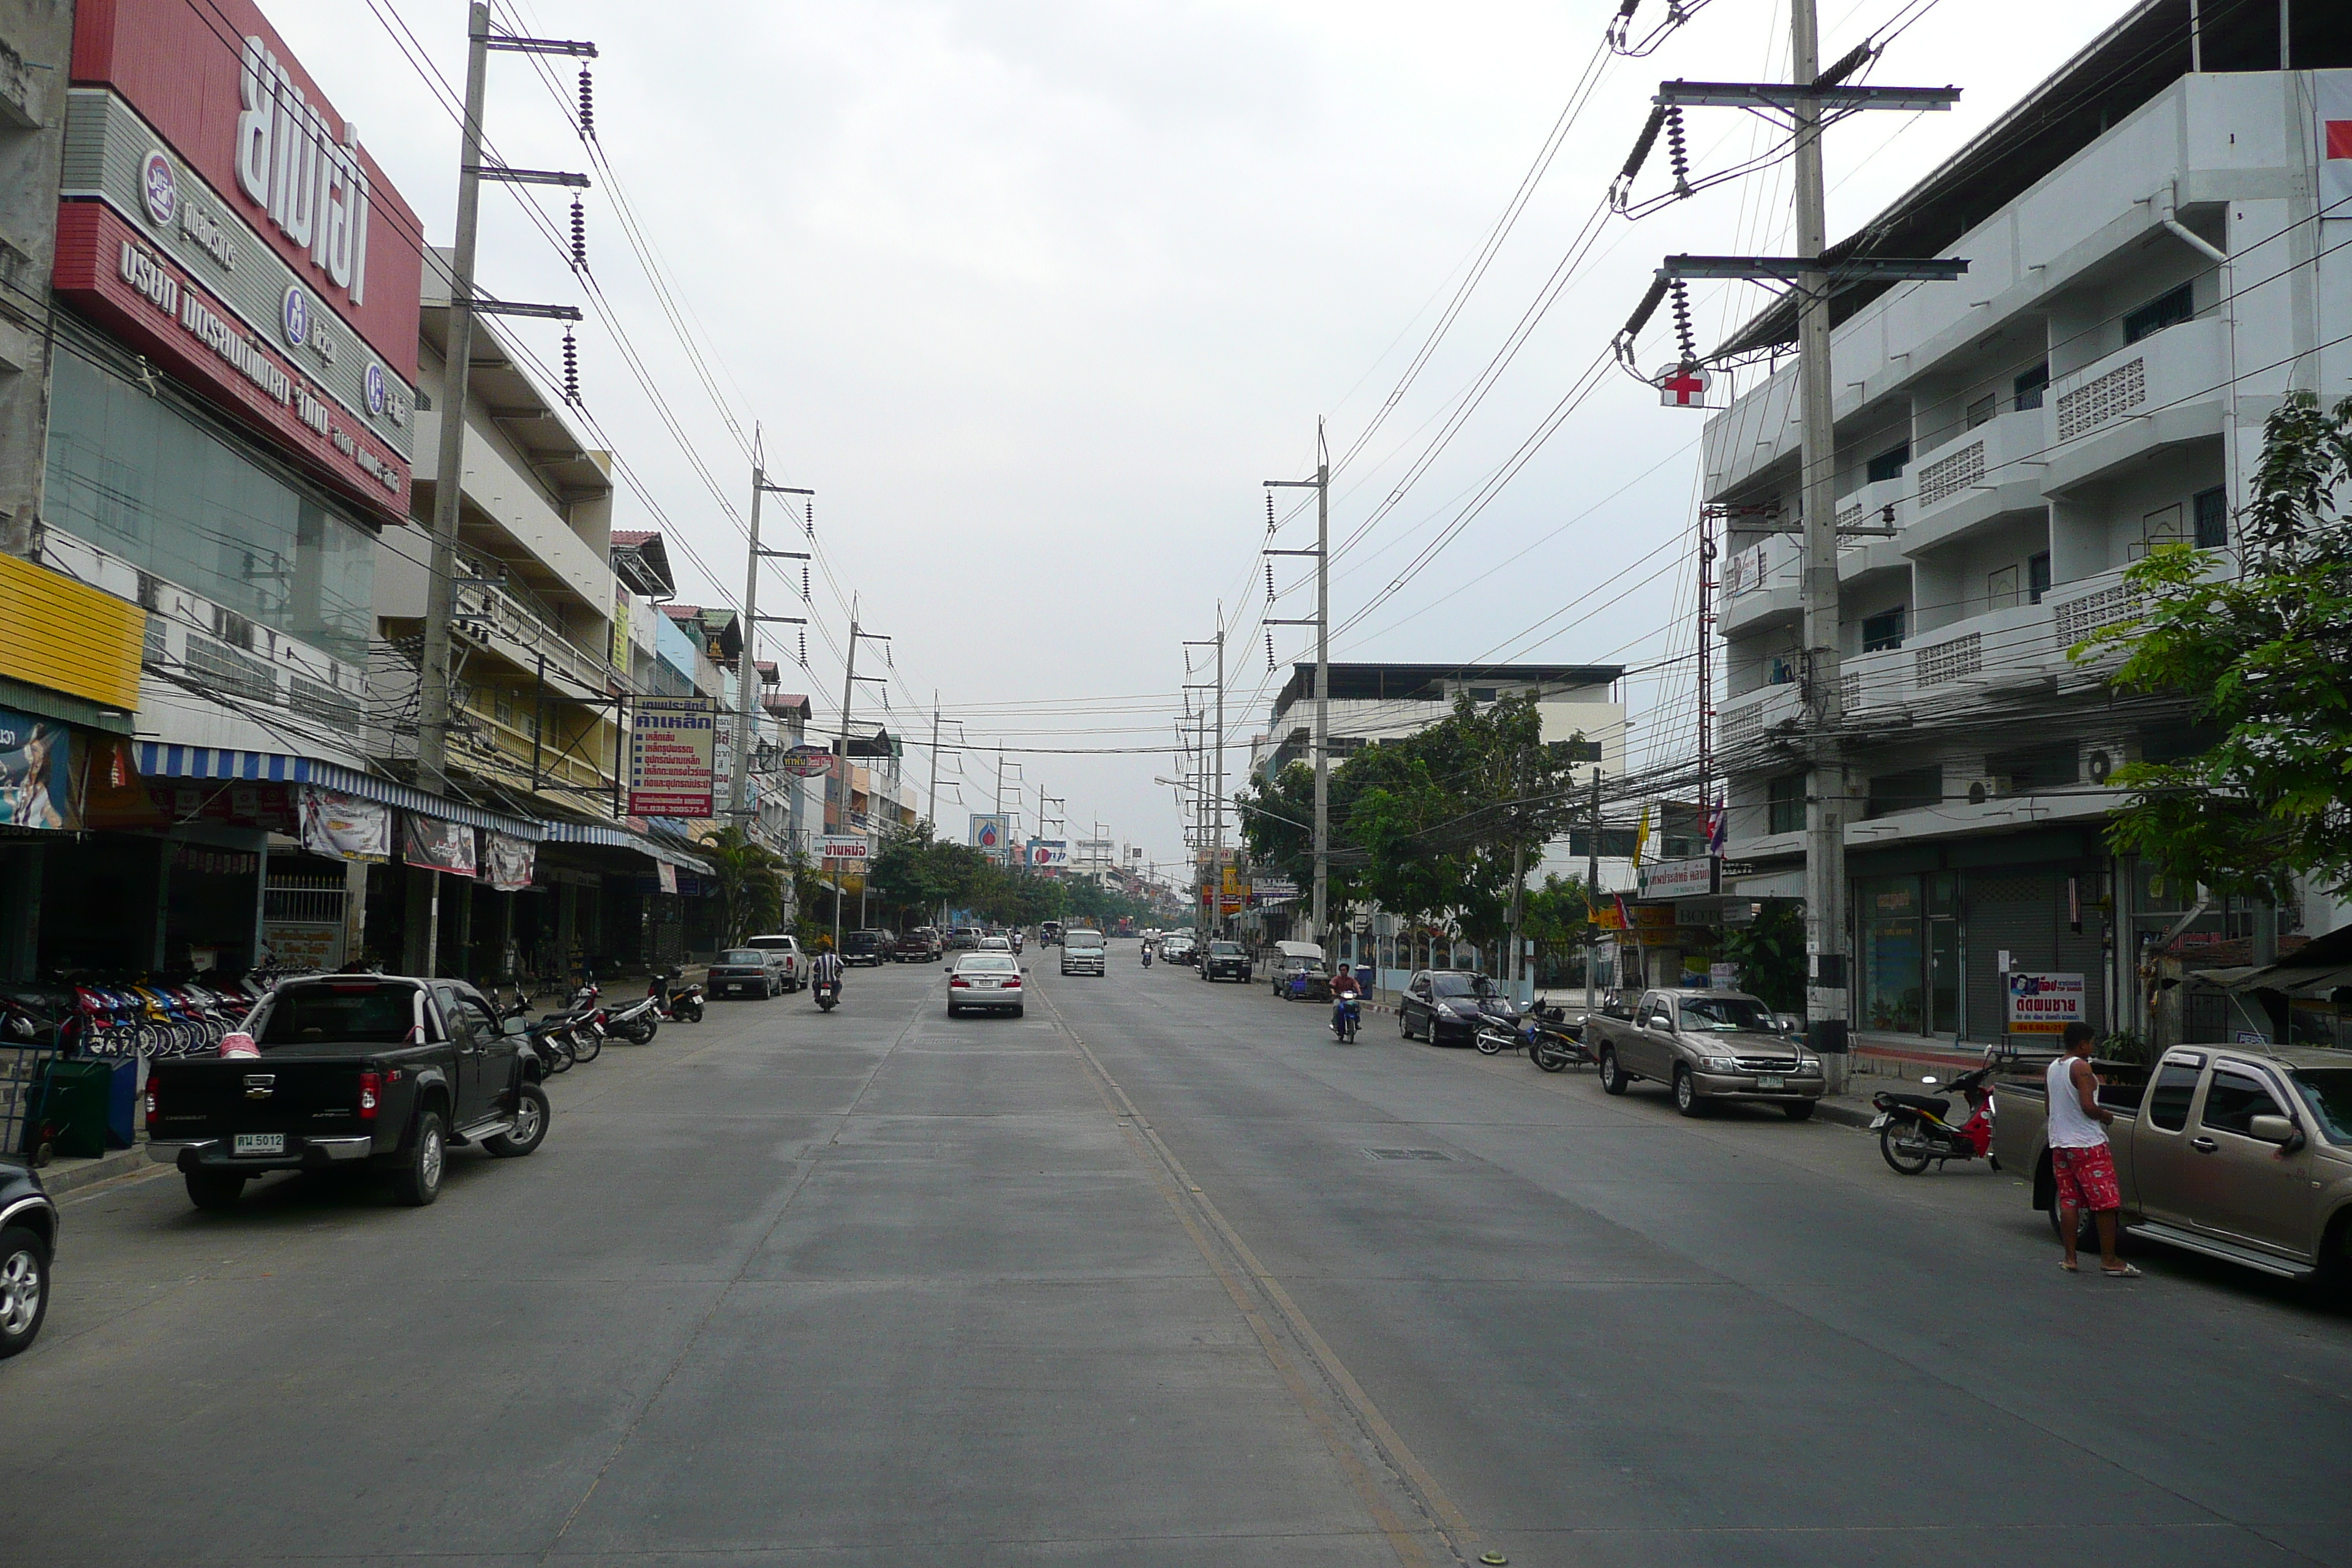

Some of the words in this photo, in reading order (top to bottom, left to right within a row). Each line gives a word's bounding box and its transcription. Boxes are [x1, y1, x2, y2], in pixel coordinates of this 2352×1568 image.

[234, 35, 369, 307] ยามาฮ่า
[183, 201, 236, 271] ศูนย์บริการ
[119, 240, 178, 317] บริษัท
[292, 378, 328, 437] จำกัด
[636, 712, 712, 729] ค้าเหล็ก
[825, 840, 867, 856] บ้านหม้อ
[1649, 862, 1689, 886] เทพประสิทธิ์
[1690, 863, 1710, 881] คลินิก
[2016, 995, 2077, 1011] ตัดผมชาย
[256, 1134, 282, 1146] 5012
